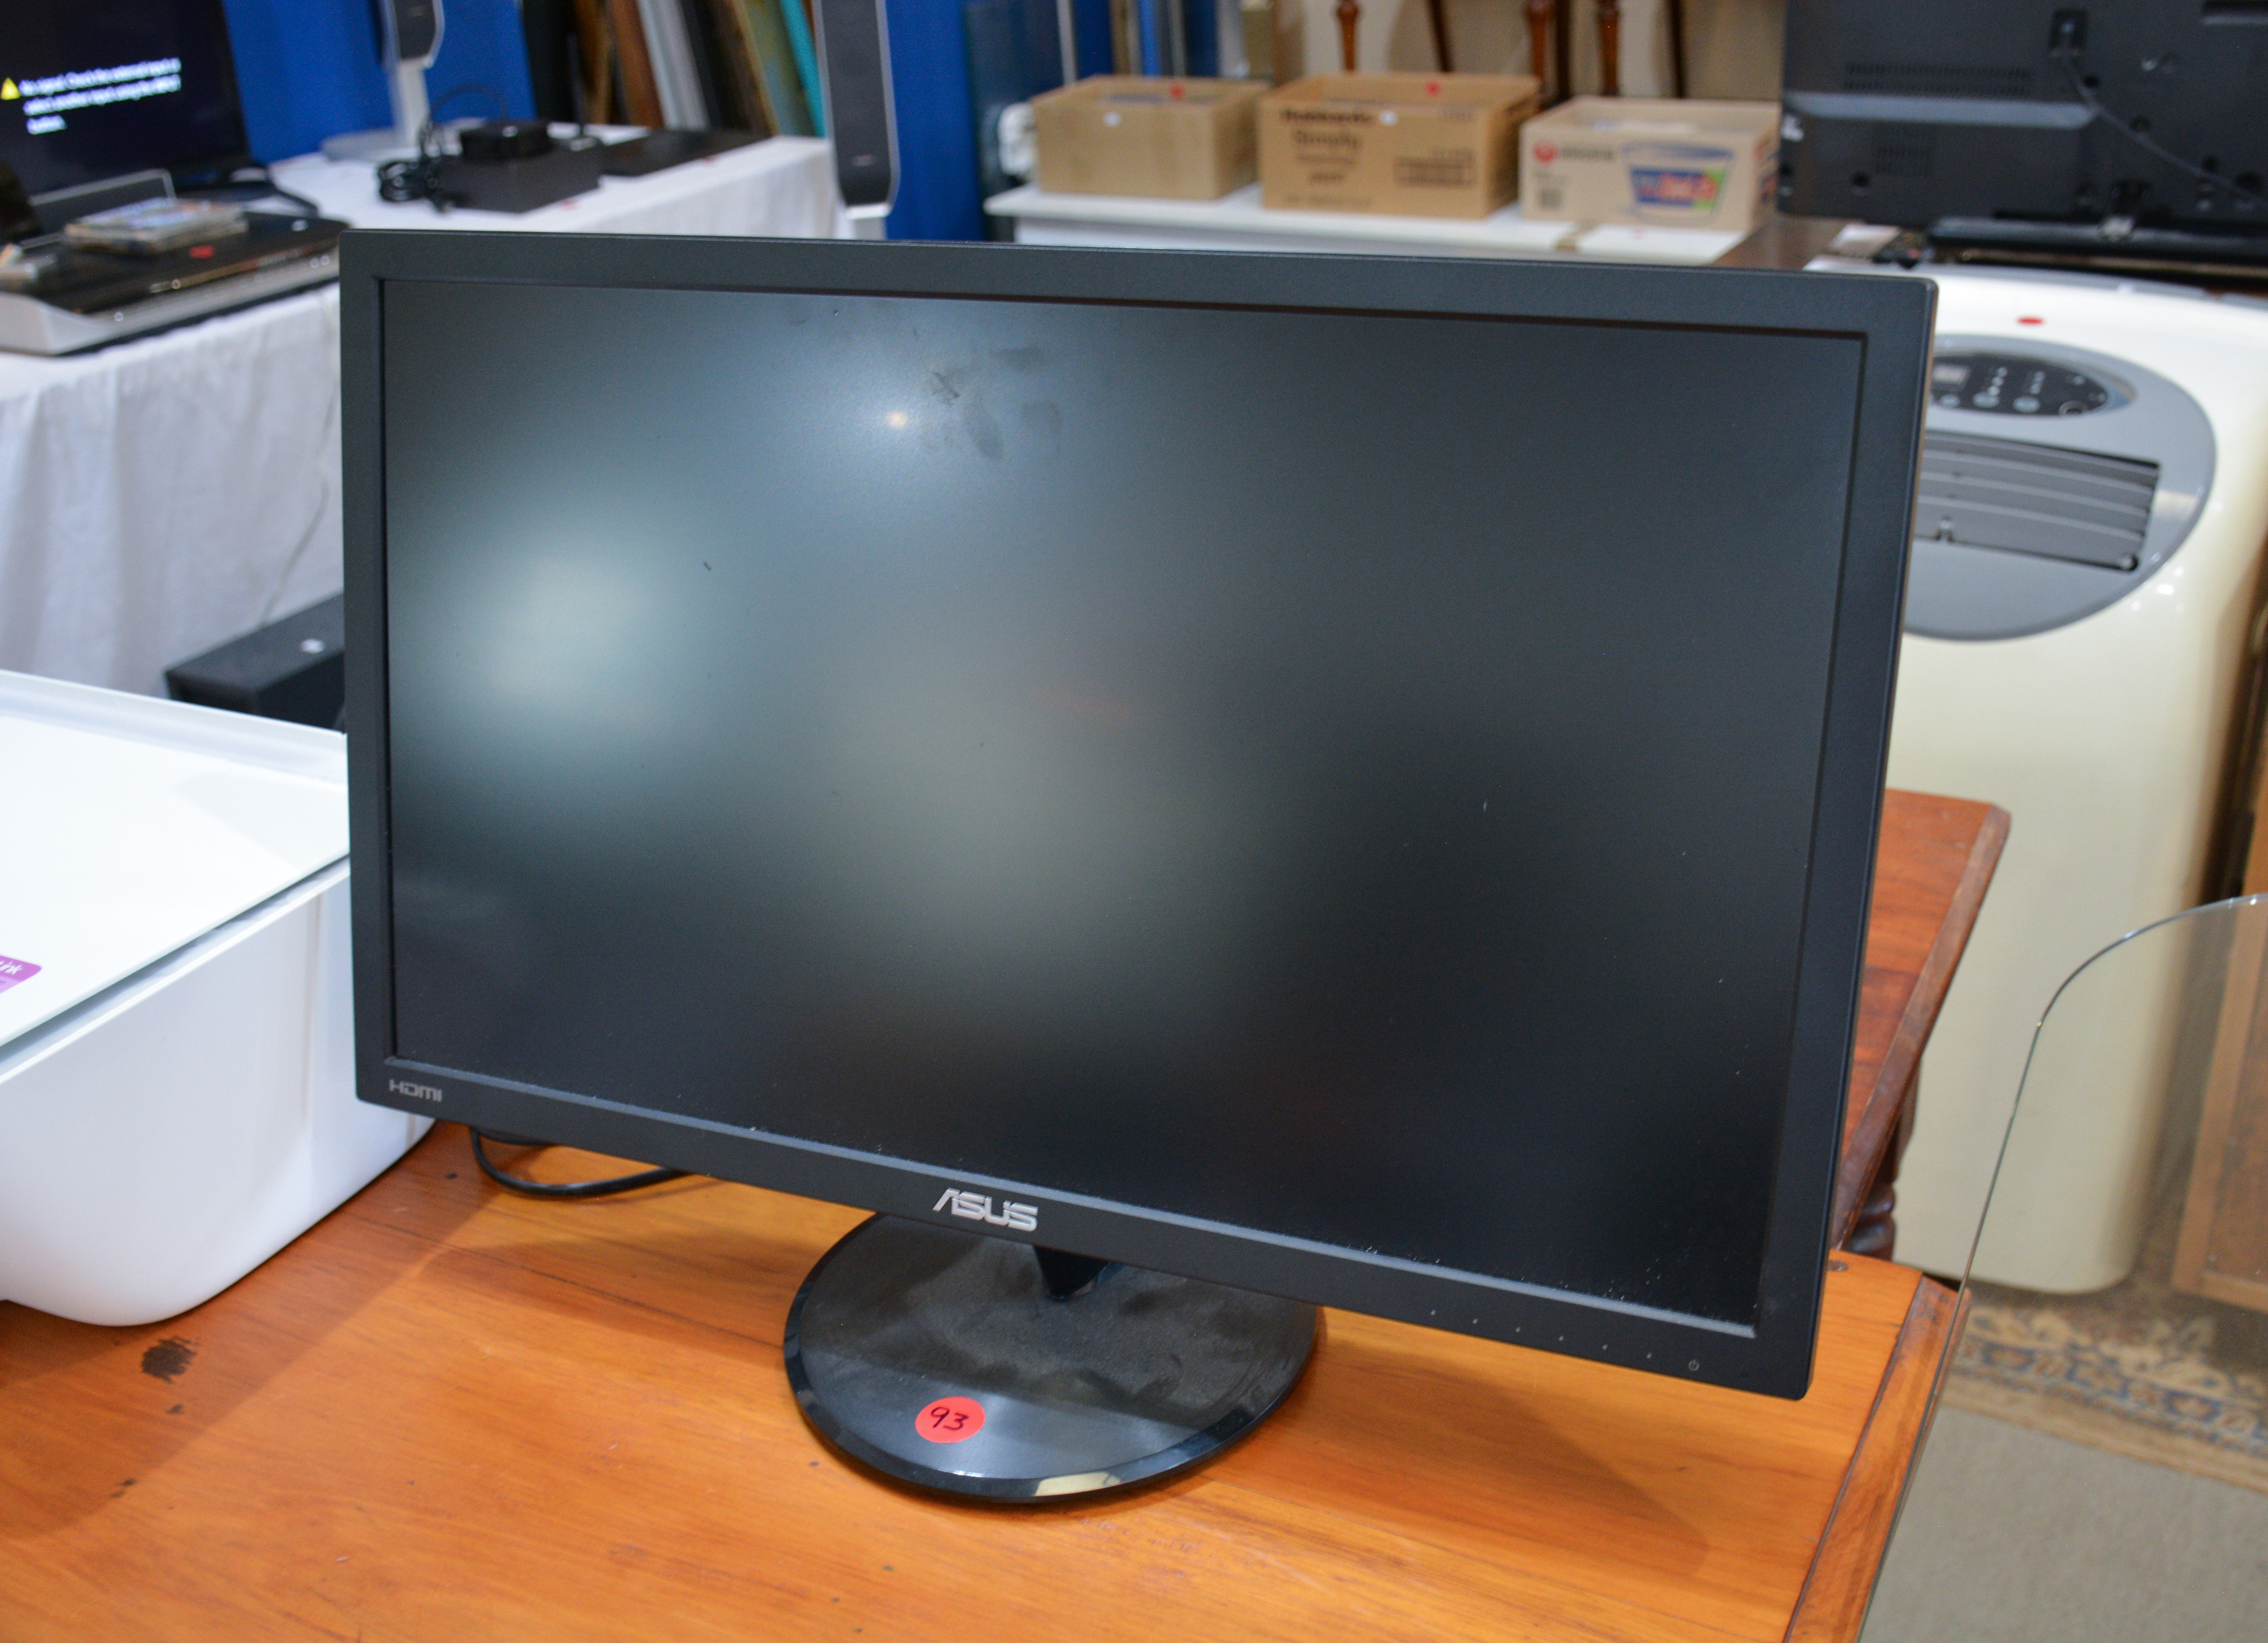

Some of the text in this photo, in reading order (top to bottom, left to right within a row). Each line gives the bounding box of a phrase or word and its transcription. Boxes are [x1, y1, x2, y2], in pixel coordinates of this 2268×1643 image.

[389, 1079, 443, 1102] HDMI
[932, 1188, 1038, 1231] ASUS
[931, 1406, 969, 1430] 93
